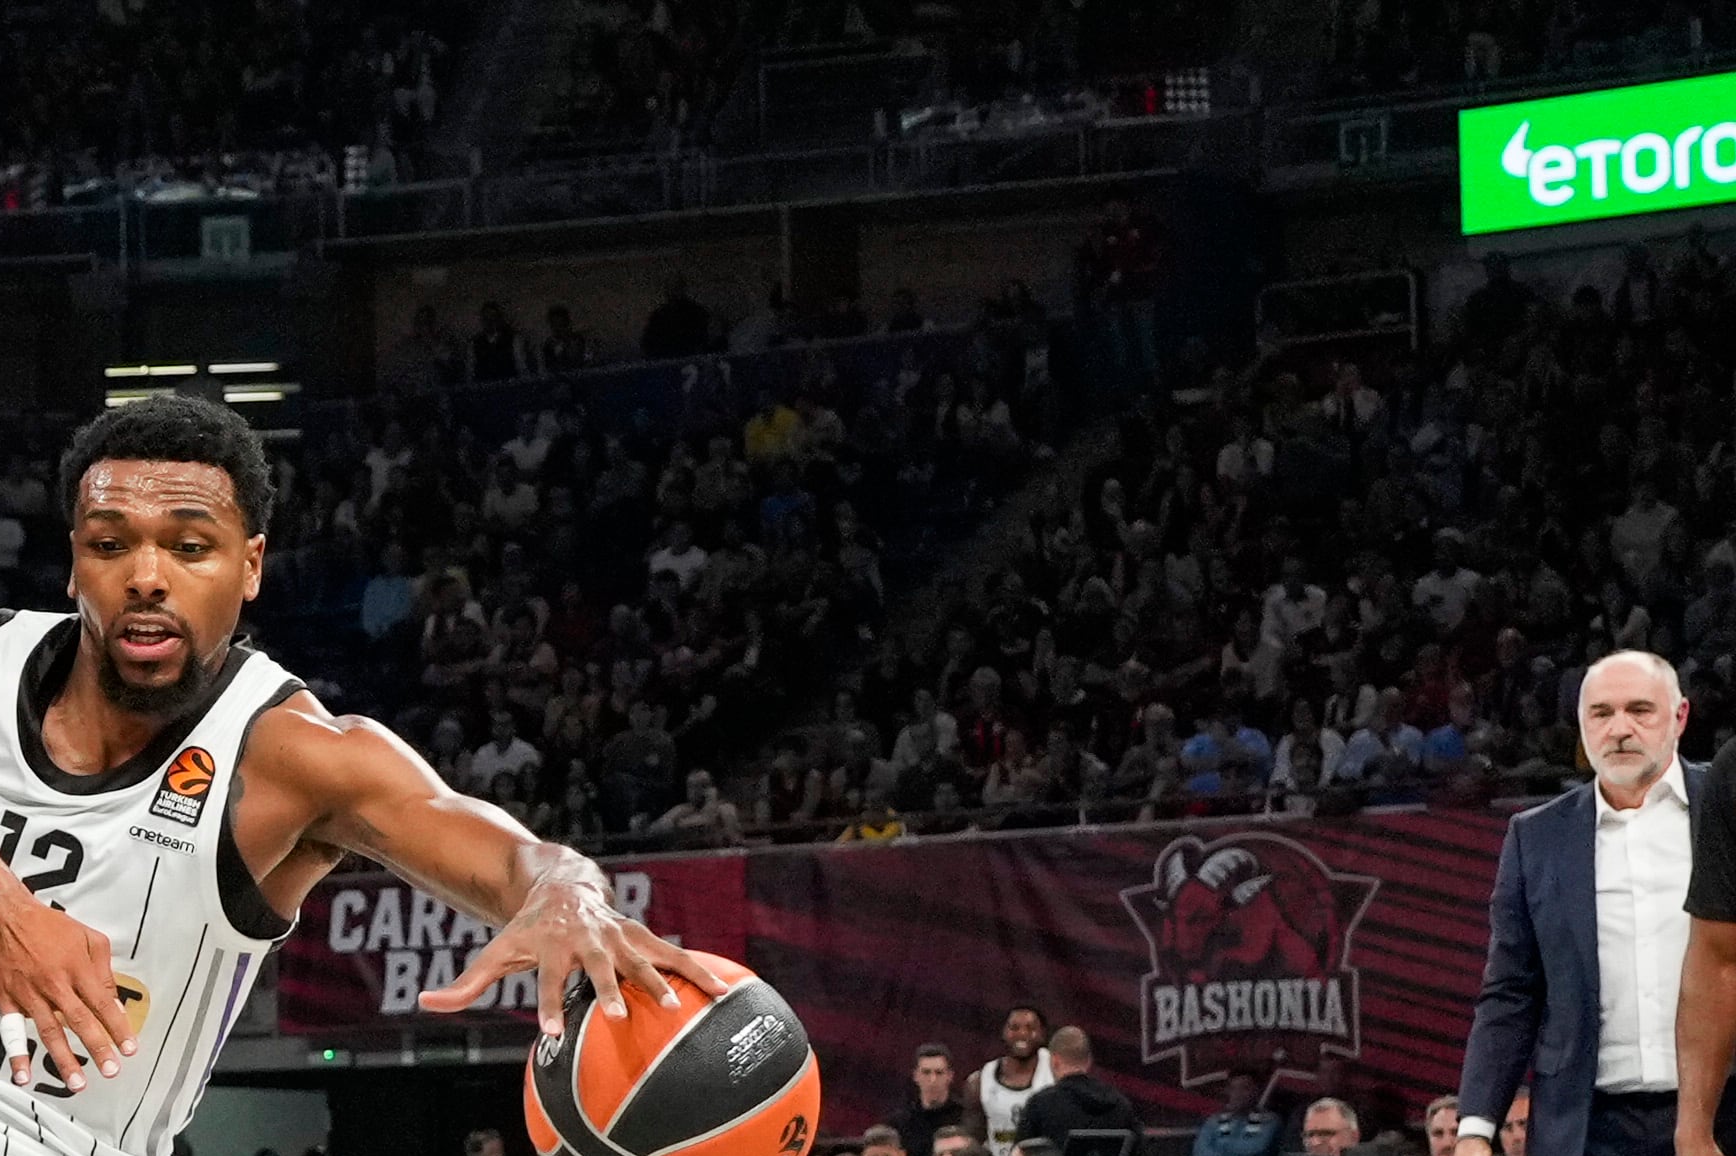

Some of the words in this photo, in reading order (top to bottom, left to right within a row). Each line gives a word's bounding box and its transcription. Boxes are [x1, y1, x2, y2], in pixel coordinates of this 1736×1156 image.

[156, 797, 199, 818] AIRLINES
[159, 789, 202, 809] TURKISH
[129, 824, 195, 855] oneteam
